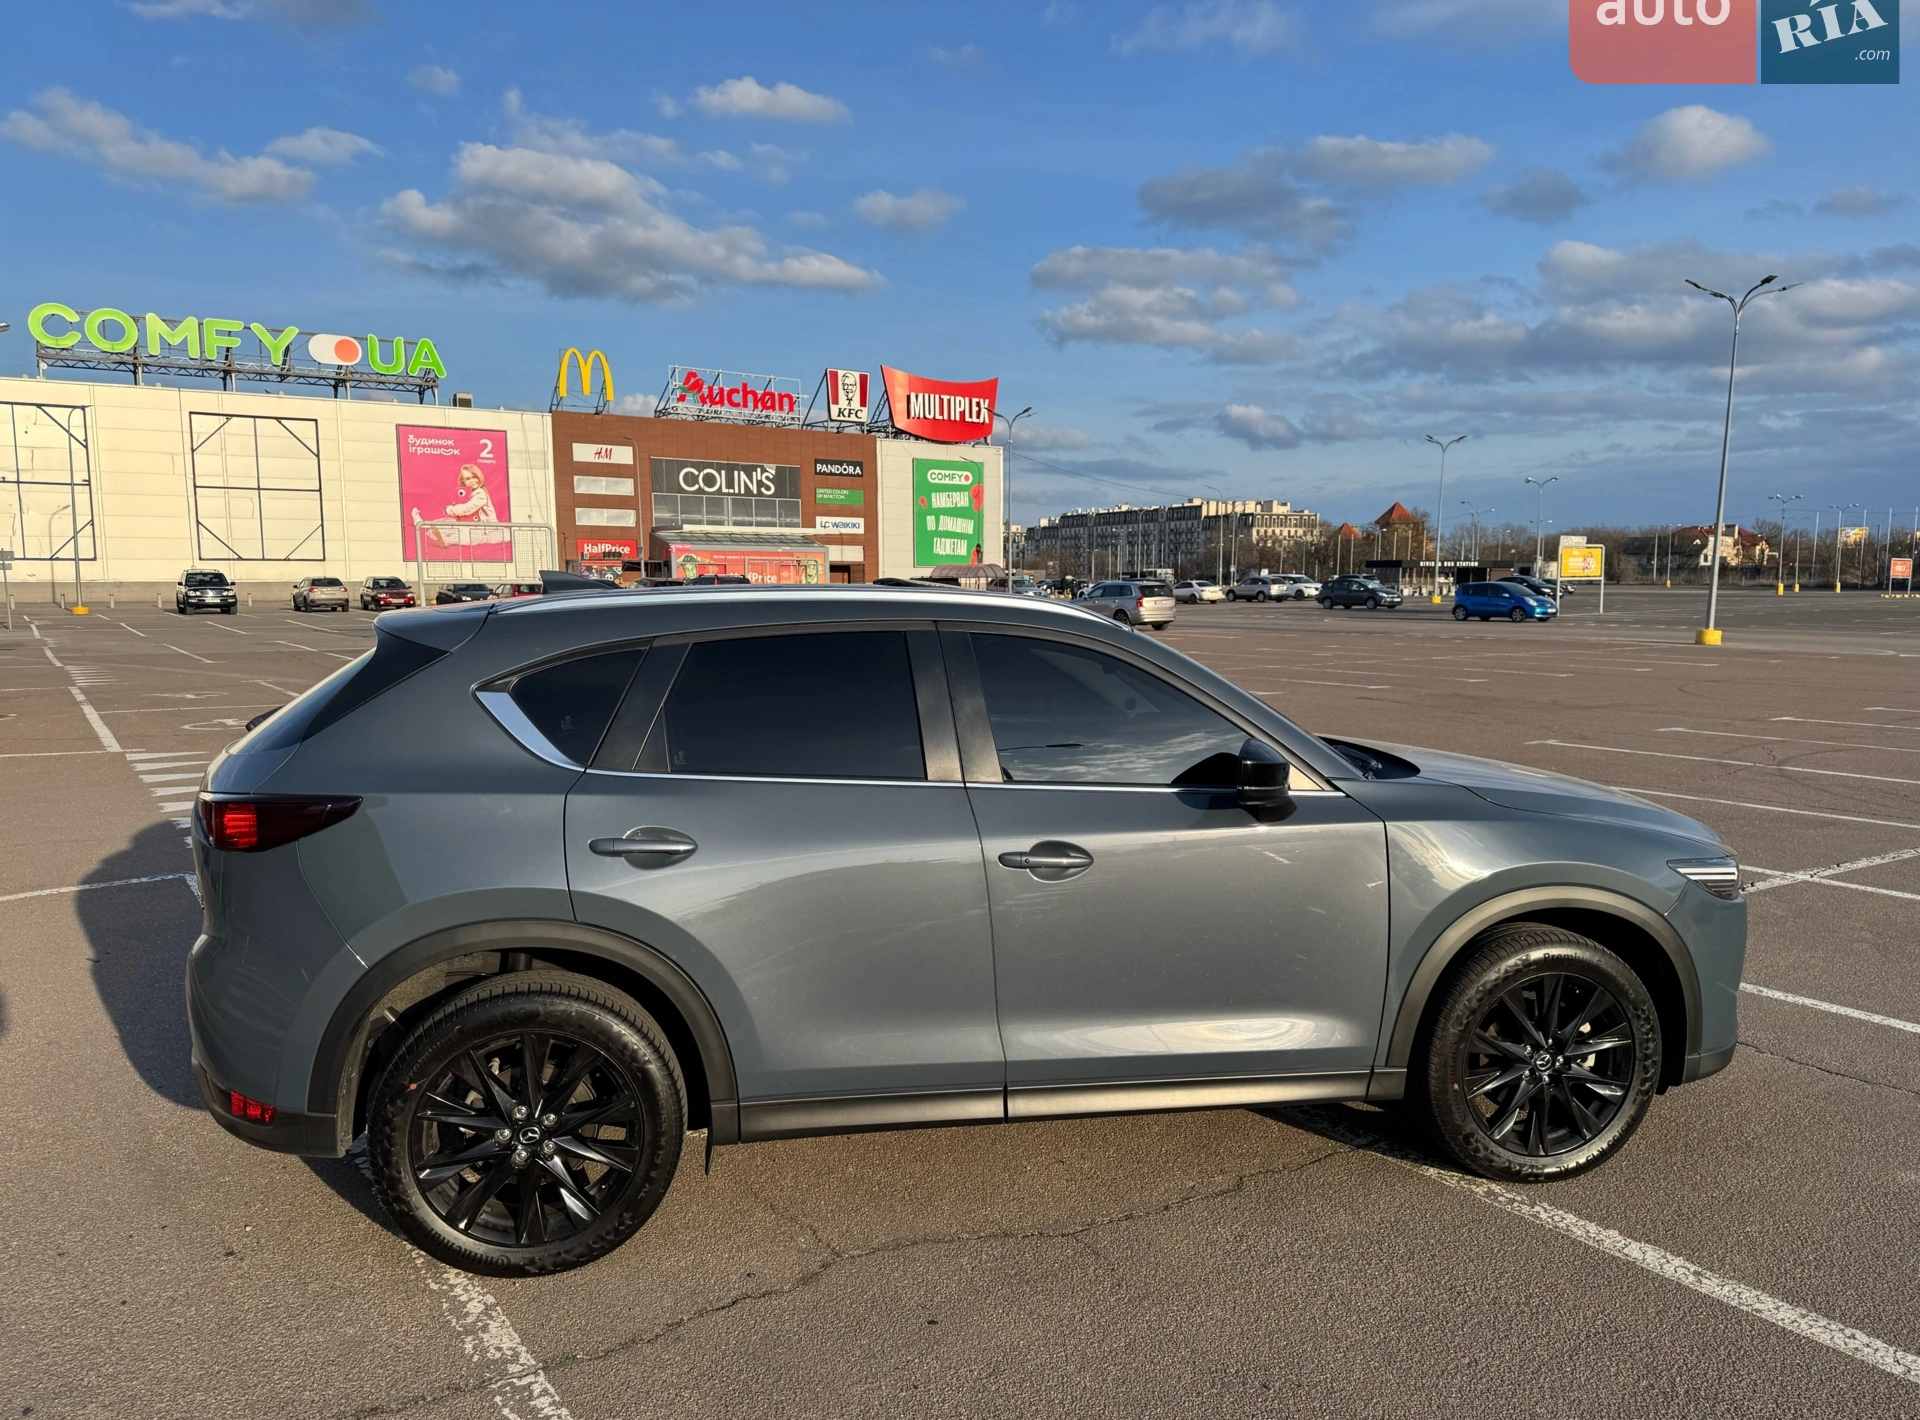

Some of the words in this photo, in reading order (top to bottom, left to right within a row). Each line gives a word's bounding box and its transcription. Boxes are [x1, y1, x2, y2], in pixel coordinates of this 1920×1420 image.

[27, 302, 300, 365] COMFY
[367, 333, 447, 379] UA
[677, 370, 795, 413] Auchan
[836, 407, 864, 419] KFC
[909, 391, 990, 424] MULTIPLEX
[479, 438, 494, 459] 2
[816, 463, 862, 475] PANDORA
[929, 472, 964, 482] COMFY
[679, 467, 776, 495] COLIN'S
[931, 491, 970, 508] НАМБЕРВАН
[820, 520, 830, 529] LC
[926, 515, 936, 531] ПО
[583, 543, 631, 554] HalfPrice
[933, 537, 968, 556] ГАДЖЕТАМ
[1607, 1113, 1637, 1148] 225/55
